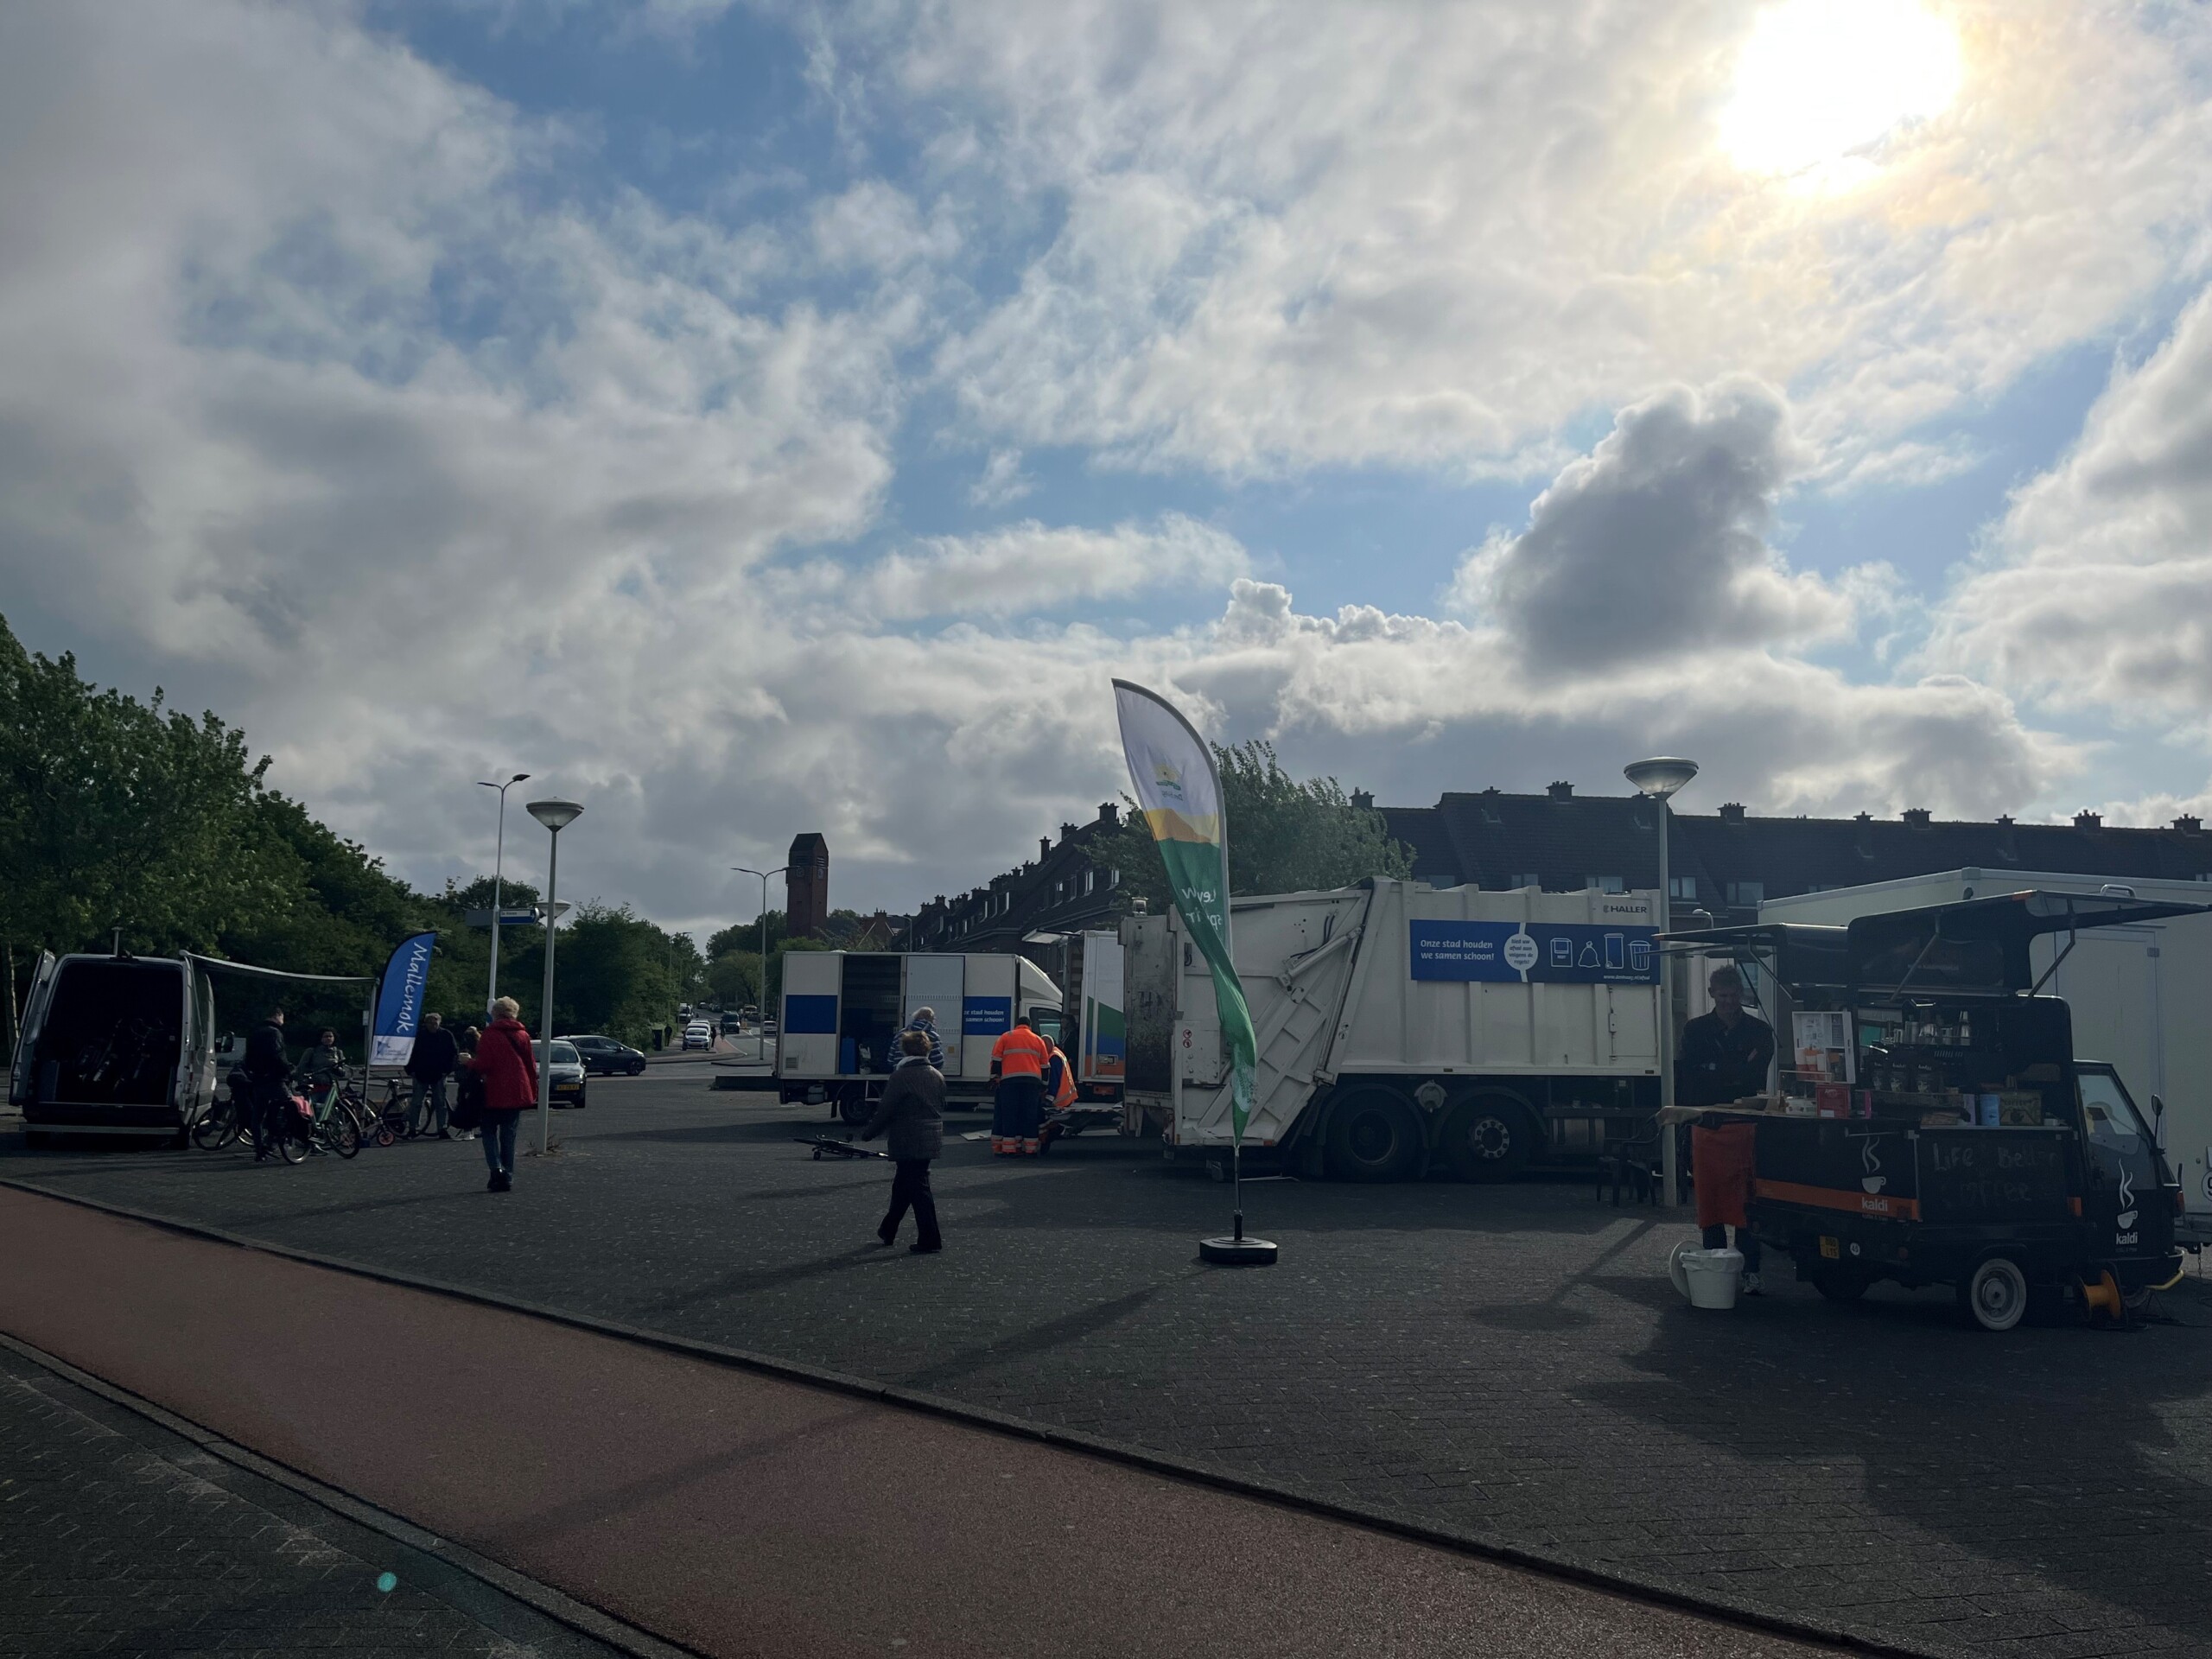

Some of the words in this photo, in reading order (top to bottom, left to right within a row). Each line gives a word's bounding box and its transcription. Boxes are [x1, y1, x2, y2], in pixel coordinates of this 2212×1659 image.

[1420, 939, 1441, 948] Onze
[1442, 940, 1461, 949] stad
[1463, 940, 1493, 950] houden
[1463, 952, 1495, 961] schoon!
[397, 942, 428, 1033] Mallemok
[1861, 1196, 1888, 1211] kaldi
[2115, 1231, 2139, 1245] kaldi
